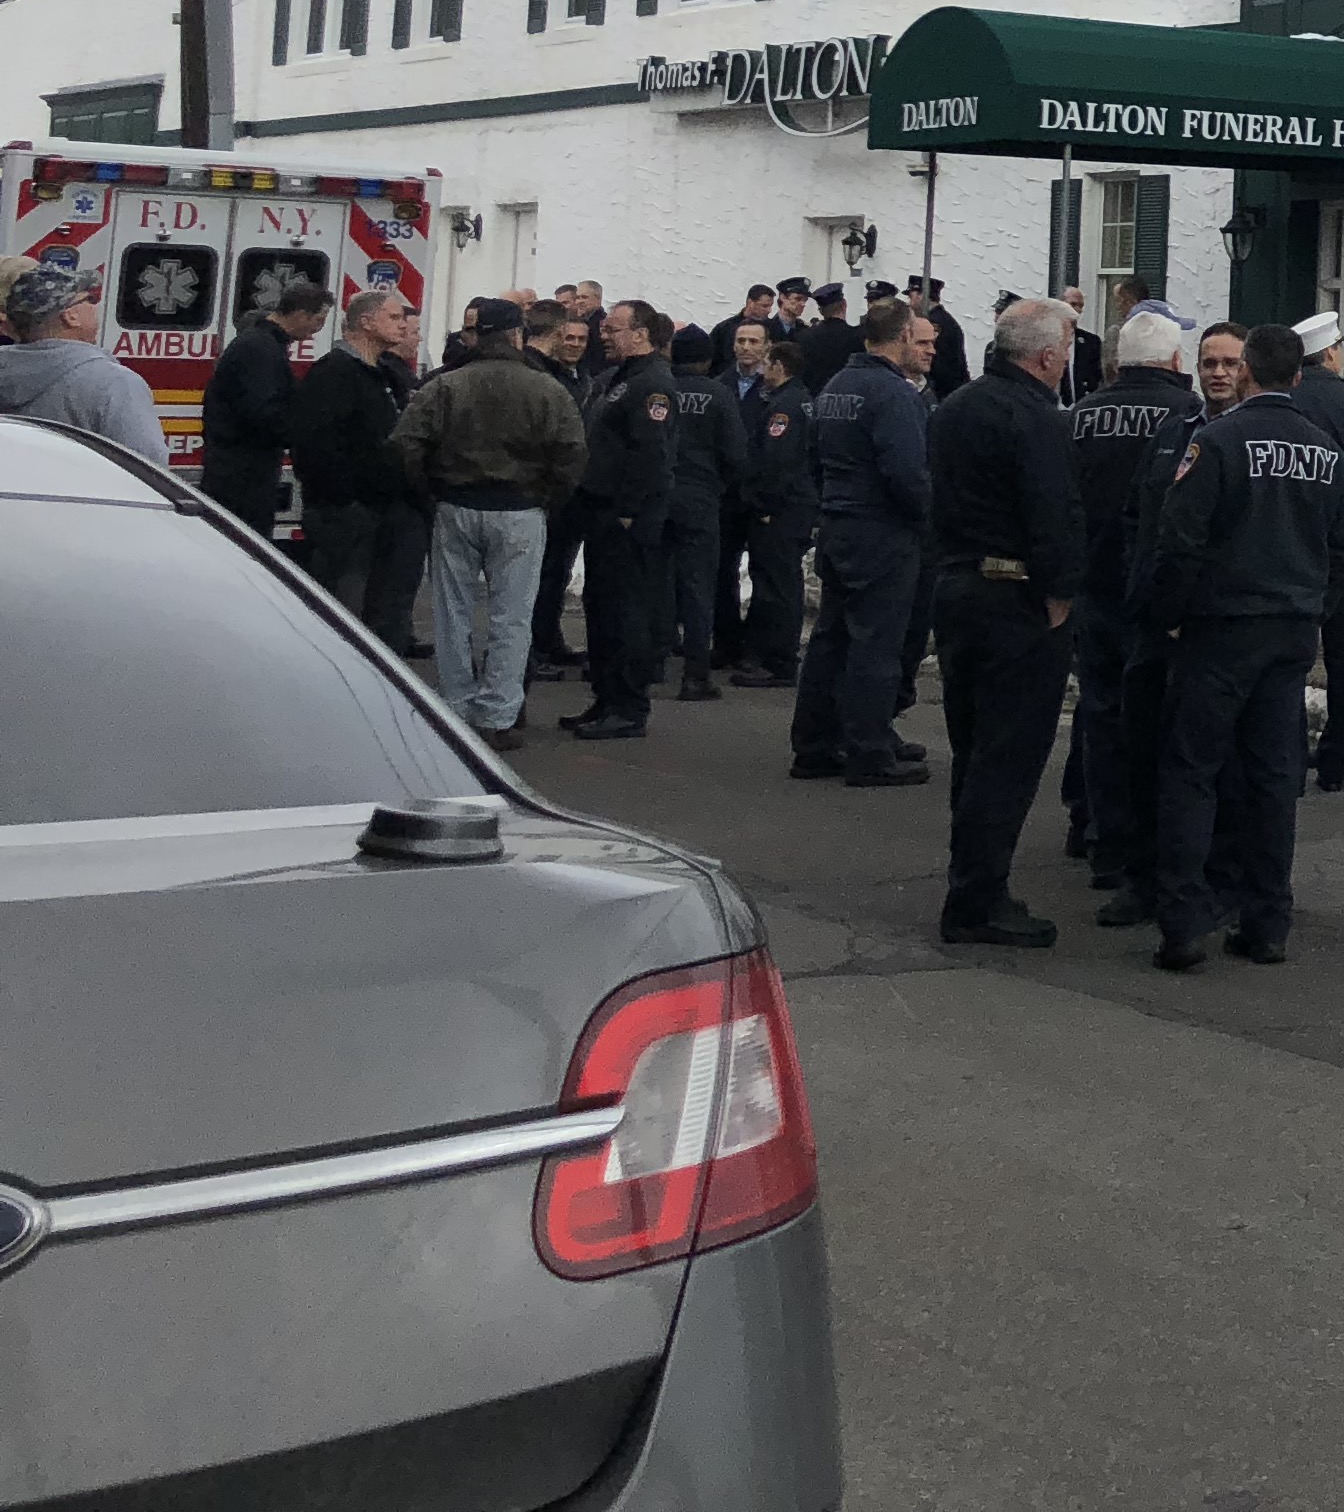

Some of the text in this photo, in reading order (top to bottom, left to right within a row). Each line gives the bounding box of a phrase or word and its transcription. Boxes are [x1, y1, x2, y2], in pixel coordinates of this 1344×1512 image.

[637, 35, 881, 136] Thomas F. DALTON
[902, 96, 979, 132] DALTON
[1039, 99, 1168, 136] DALTON
[1181, 109, 1323, 147] FUNERAL
[140, 199, 322, 237] F.D. N.Y.
[1073, 405, 1169, 440] FDNY
[1245, 440, 1339, 485] FDNY
